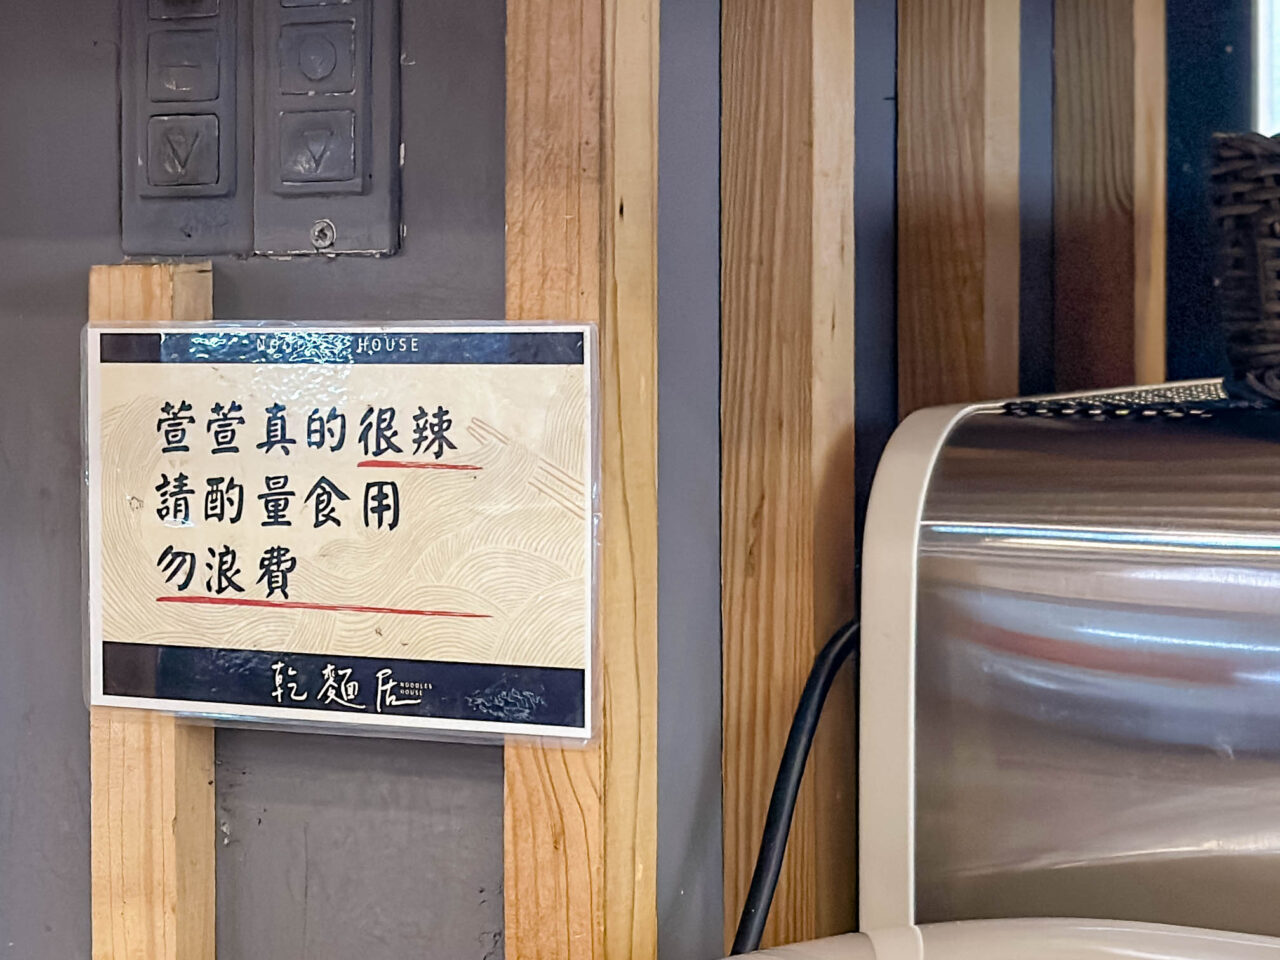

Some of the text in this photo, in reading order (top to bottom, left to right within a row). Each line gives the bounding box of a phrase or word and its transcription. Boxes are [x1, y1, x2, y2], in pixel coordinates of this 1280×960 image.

[357, 336, 420, 353] HOUSE
[156, 399, 458, 460] 萱萱真的很辣
[155, 472, 401, 532] 請酌量食用
[156, 544, 297, 600] 勿浪費
[271, 660, 422, 713] 乾麵居
